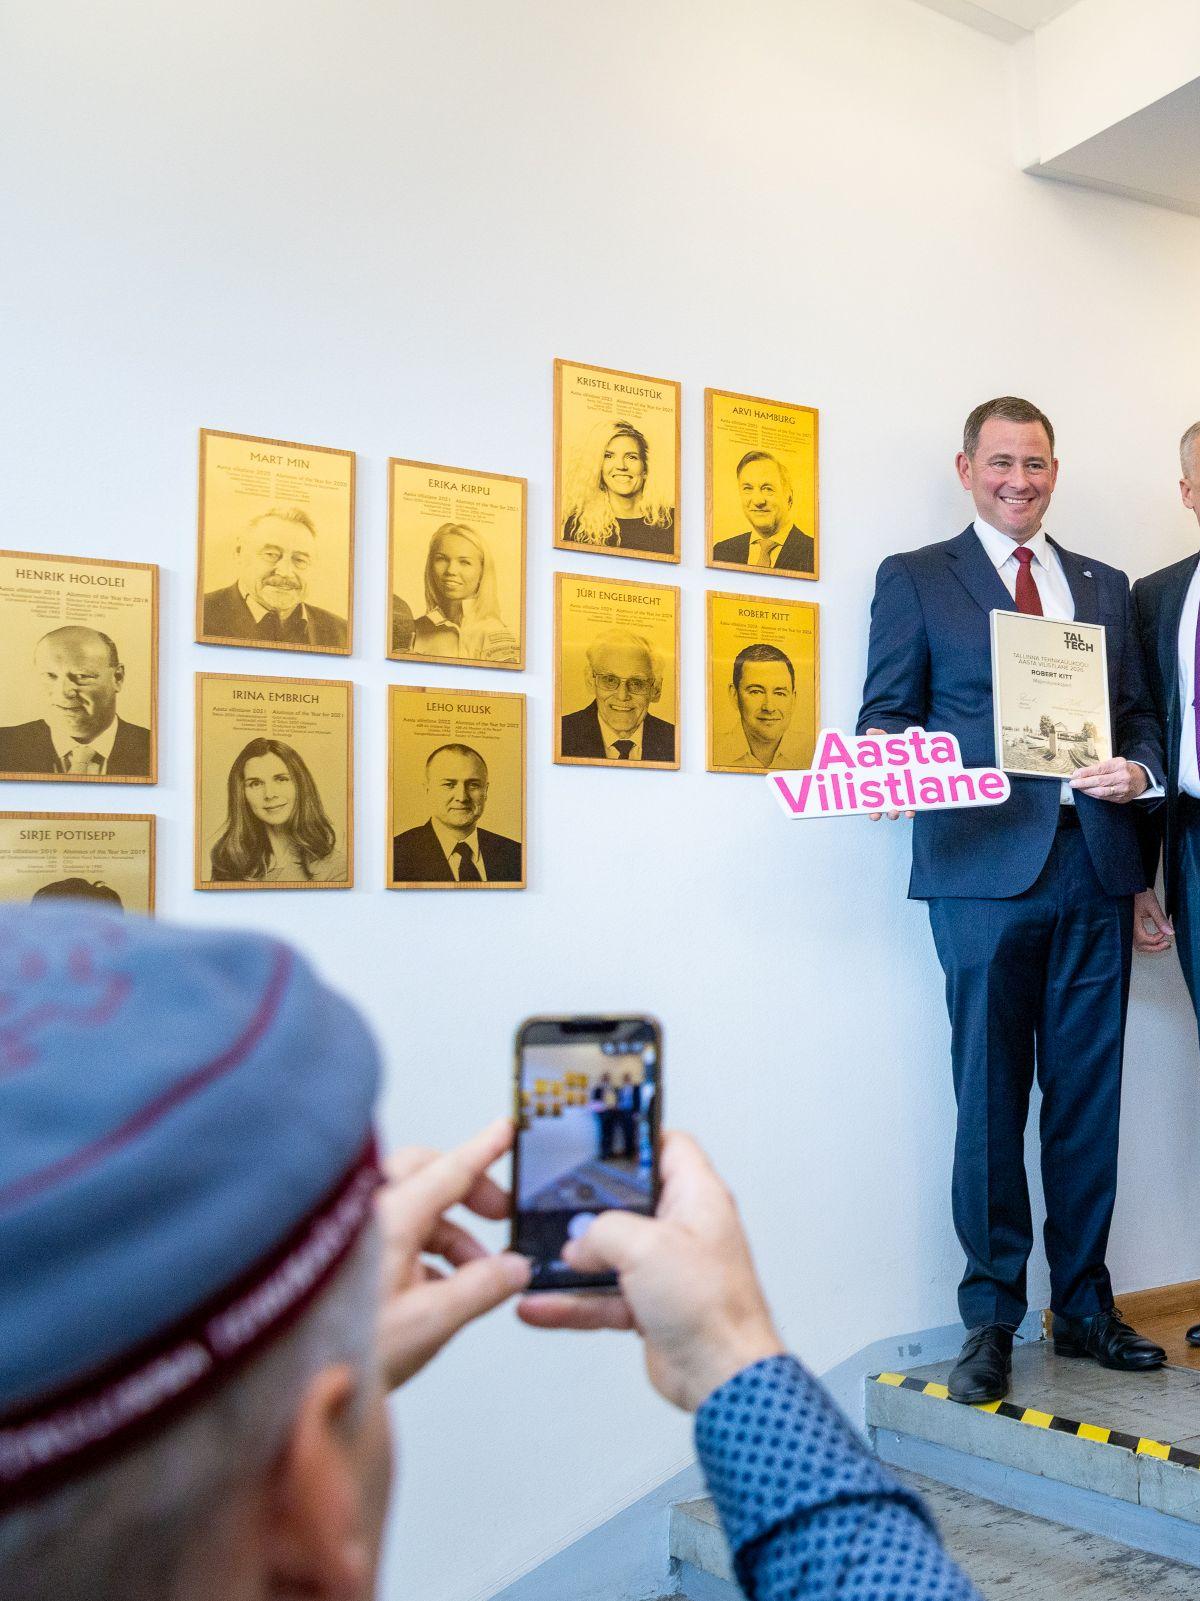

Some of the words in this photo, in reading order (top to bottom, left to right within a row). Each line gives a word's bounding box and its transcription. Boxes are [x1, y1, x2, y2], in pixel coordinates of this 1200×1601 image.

[577, 376, 612, 391] KRISTEL
[613, 384, 663, 400] KRUUSTÜK
[732, 407, 752, 417] ARVI
[754, 410, 796, 425] HAMBURG
[250, 452, 283, 465] MART
[287, 458, 310, 469] MIN
[428, 479, 457, 491] ERIKA
[461, 483, 490, 496] KIRPU
[16, 568, 65, 582] HENRIK
[70, 573, 125, 588] HOLOLEI
[576, 588, 596, 598] JÜRI
[599, 591, 661, 606] ENGELBRECHT
[738, 608, 770, 619] ROBERT
[771, 612, 790, 621] KITT
[1064, 632, 1084, 642] TAL
[1064, 640, 1094, 652] TECH
[1031, 669, 1057, 678] ROBERT
[232, 690, 265, 701] IRINA
[269, 692, 319, 704] EMBRICH
[426, 702, 454, 712] LEHO
[457, 704, 491, 714] KUUSK
[818, 731, 957, 771] Aasta
[773, 769, 1005, 813] Vilistlane
[20, 830, 51, 841] SIRJE
[56, 831, 116, 840] POTISEPP
